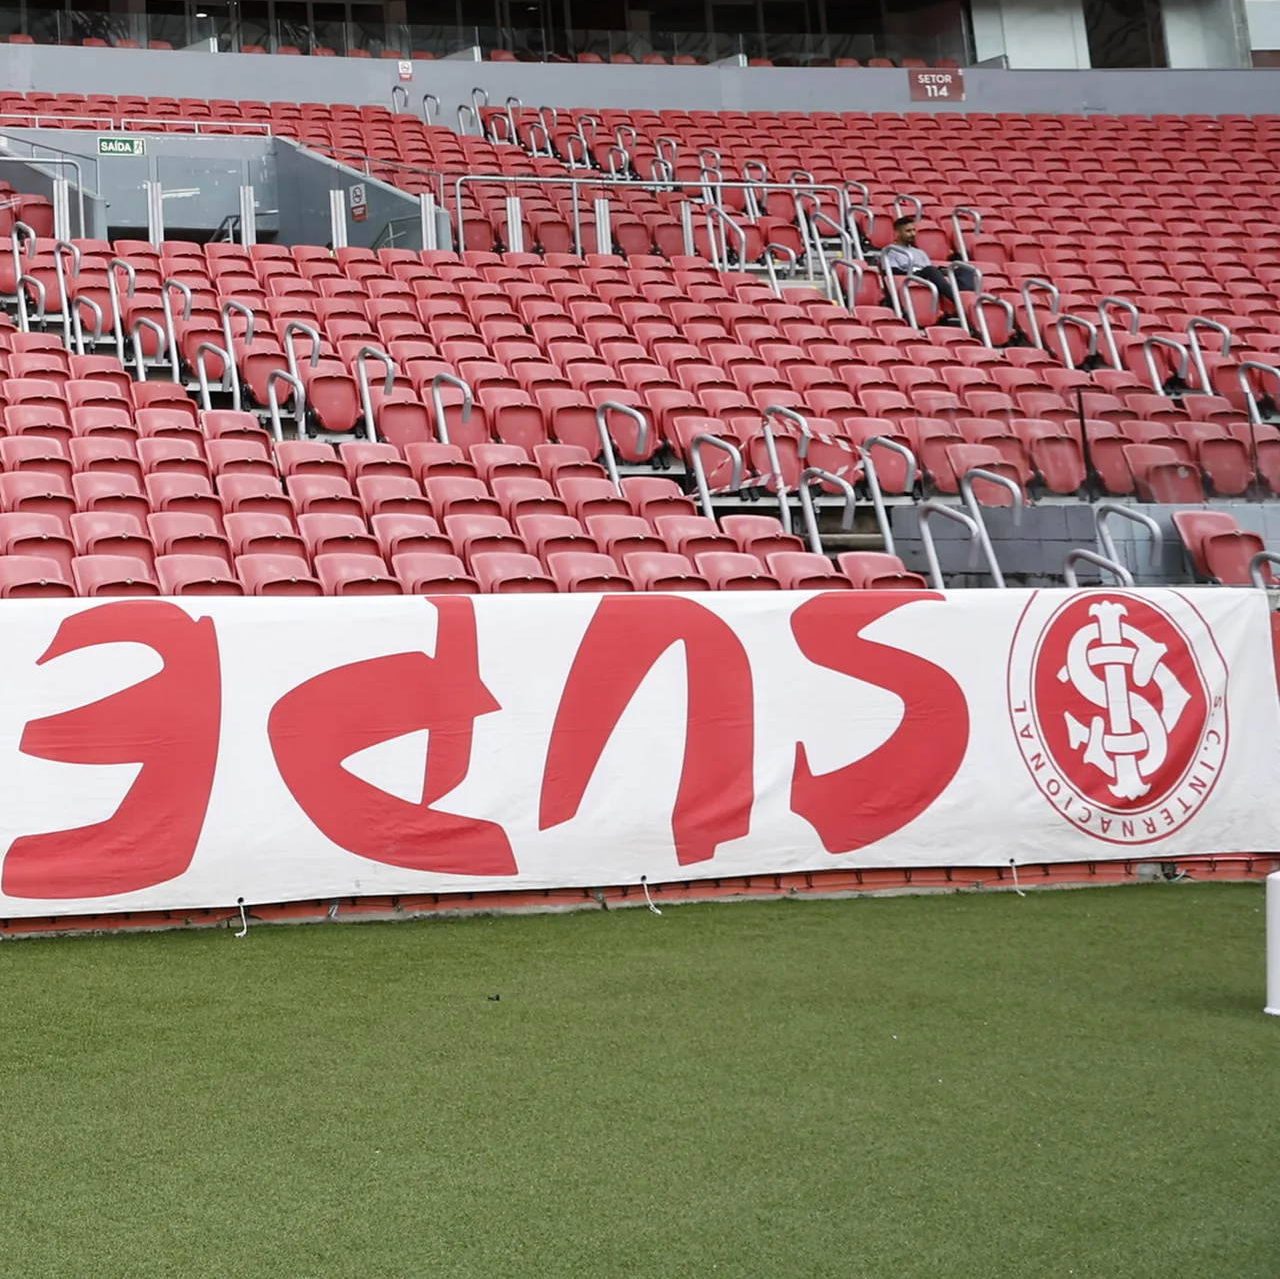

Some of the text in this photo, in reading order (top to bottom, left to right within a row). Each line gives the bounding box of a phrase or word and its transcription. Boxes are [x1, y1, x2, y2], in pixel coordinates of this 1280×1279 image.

[917, 73, 953, 84] SETOR
[925, 84, 949, 98] 114
[100, 137, 132, 152] SAÍDA
[1013, 699, 1216, 838] INTERNACIONAL
